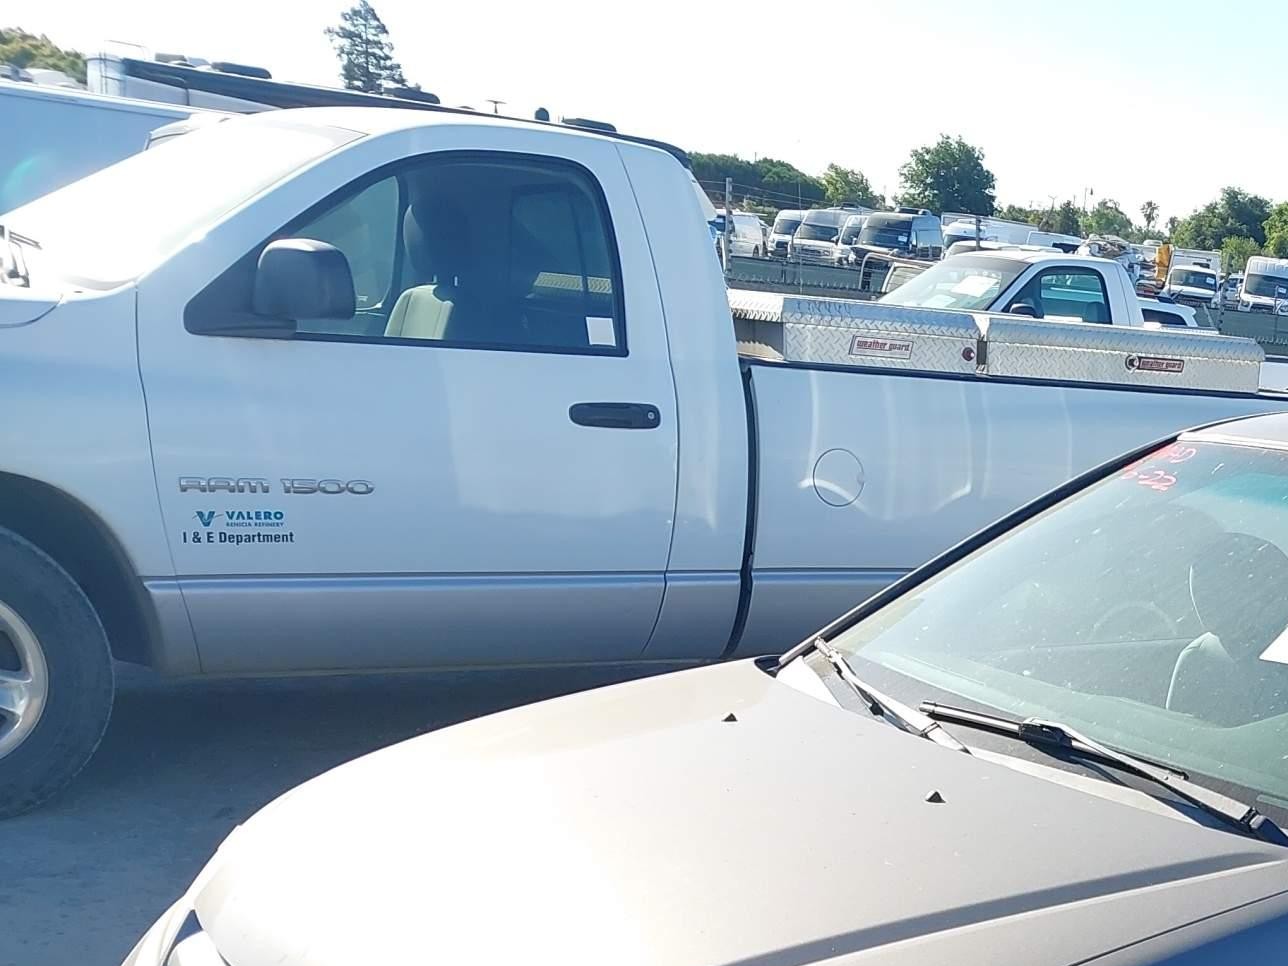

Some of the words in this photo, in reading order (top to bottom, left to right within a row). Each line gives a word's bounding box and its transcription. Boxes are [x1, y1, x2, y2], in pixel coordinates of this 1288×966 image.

[178, 476, 270, 494] RAM
[279, 477, 375, 495] 1500
[225, 510, 285, 521] VALERO
[182, 531, 187, 543] I
[191, 531, 202, 544] &
[206, 531, 215, 544] E
[218, 531, 295, 546] Department
